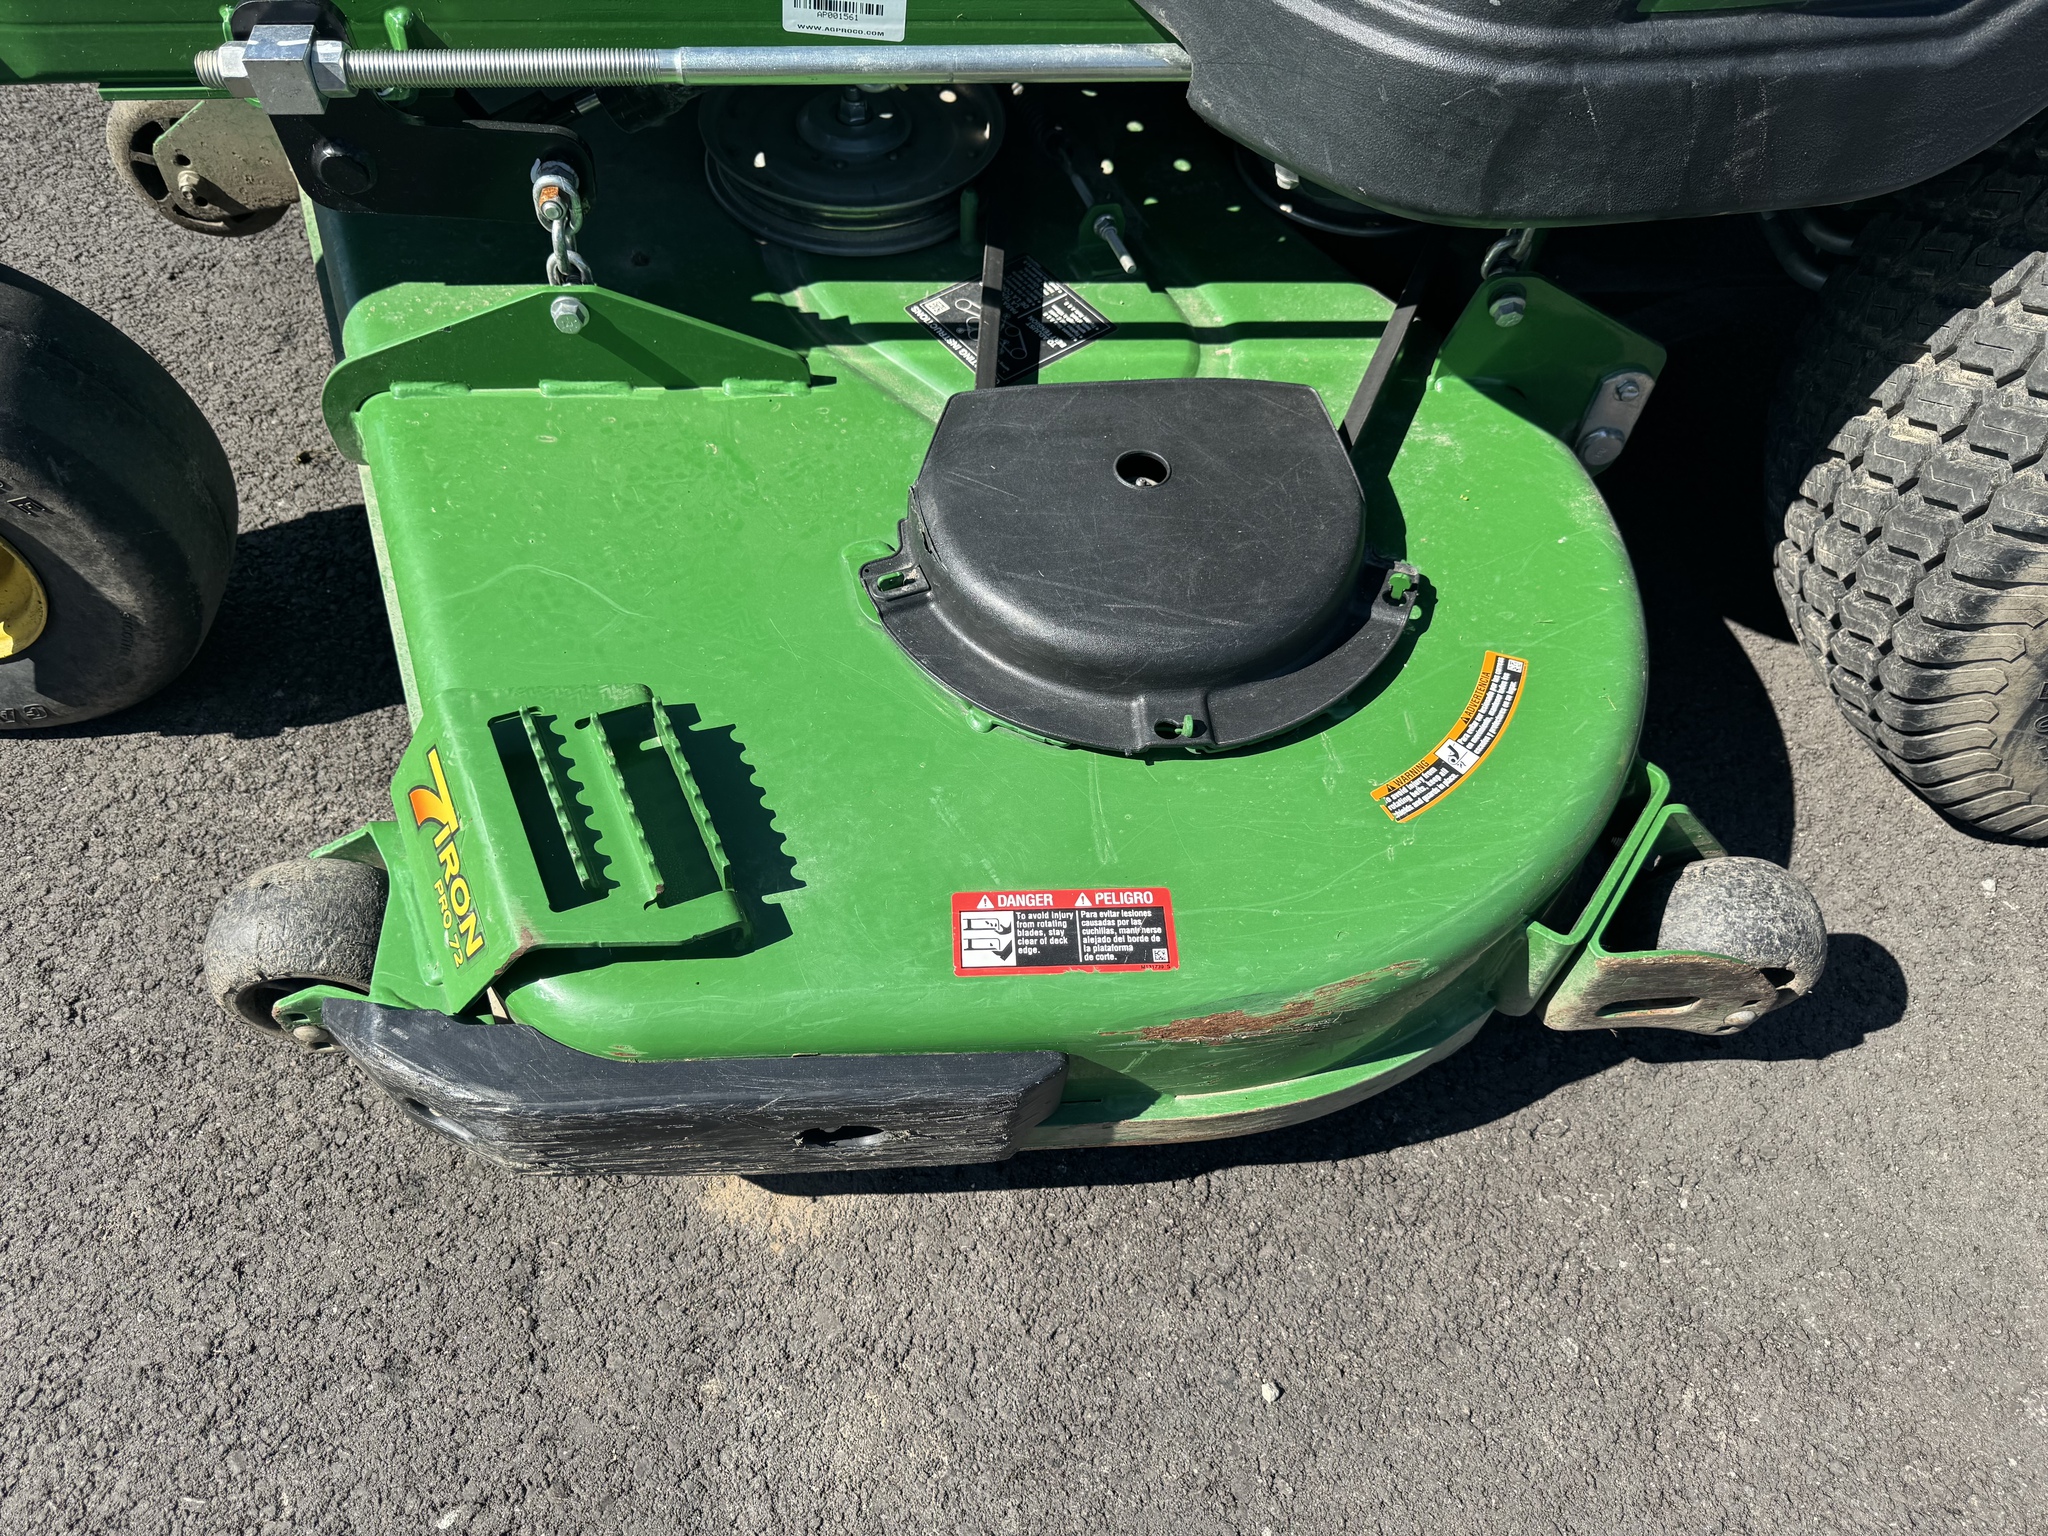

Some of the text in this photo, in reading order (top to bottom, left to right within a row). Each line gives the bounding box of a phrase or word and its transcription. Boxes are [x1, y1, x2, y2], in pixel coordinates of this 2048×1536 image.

[817, 11, 858, 21] AP001561
[797, 24, 884, 36] WWW.AGPROCO.COM
[1465, 671, 1490, 717] ADVERTENCIA
[1393, 759, 1429, 787] WARNING
[998, 894, 1053, 907] DANGER
[1095, 891, 1153, 905] PELIGRO
[1052, 911, 1073, 920] injury
[434, 878, 464, 969] PRO 72
[1037, 920, 1067, 928] rotating
[1117, 919, 1129, 927] por
[1082, 927, 1117, 935] cuchillas,
[1083, 936, 1111, 944] alejado
[1151, 934, 1160, 942] de
[1018, 947, 1040, 955] edge.
[1093, 944, 1133, 953] plataforma
